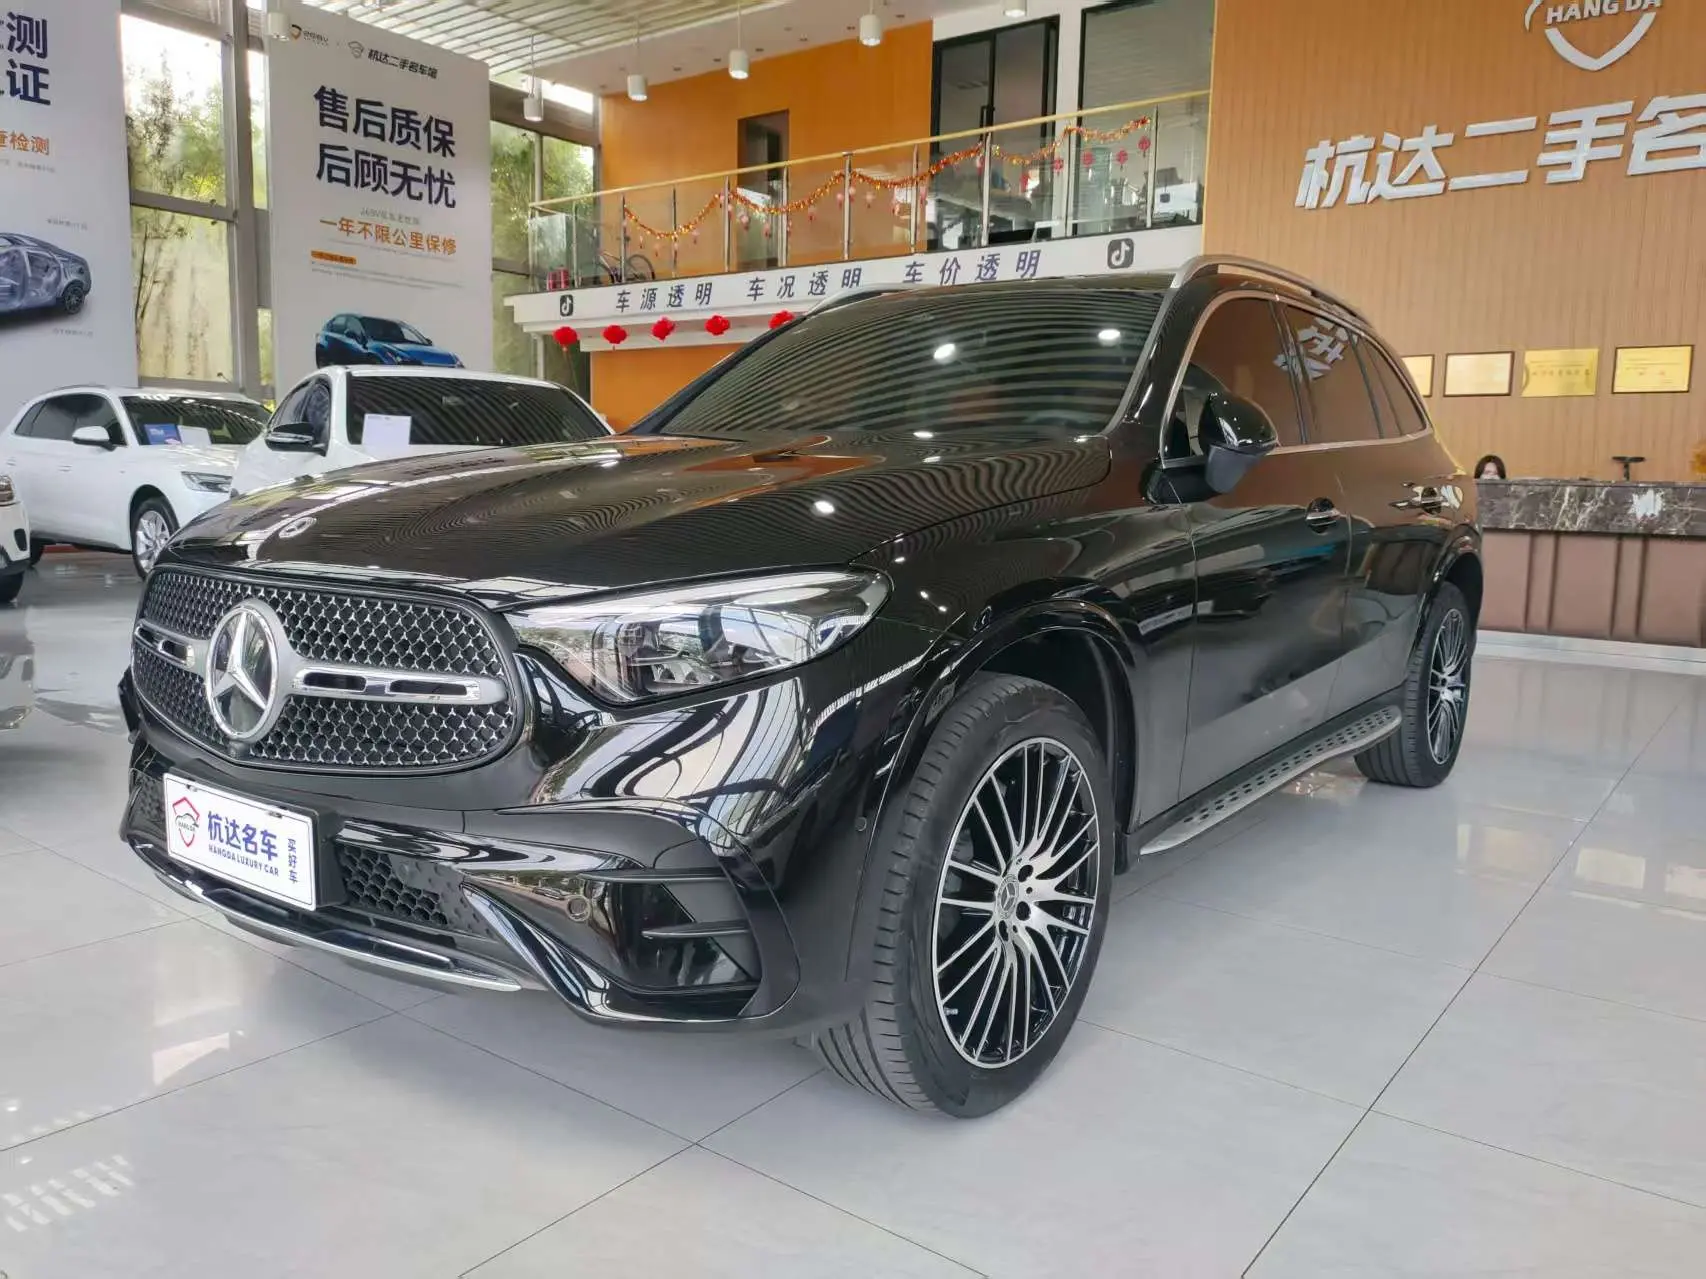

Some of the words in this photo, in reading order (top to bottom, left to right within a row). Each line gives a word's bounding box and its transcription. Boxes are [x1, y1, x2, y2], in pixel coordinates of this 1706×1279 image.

[0, 12, 47, 59] 测
[1546, 0, 1619, 24] HANG
[0, 58, 51, 105] 证
[313, 85, 456, 158] 售后质保
[1295, 93, 1706, 210] 杭达二手名
[316, 143, 456, 209] 后顾无忧
[319, 216, 457, 256] 一年不限公里保修
[615, 282, 713, 312] 车源透明
[746, 267, 862, 301] 车况透明
[902, 250, 1042, 285] 车价透明
[207, 811, 278, 861] 杭达名车
[208, 843, 235, 861] HANGDA
[236, 853, 262, 871] LUXURY
[264, 863, 279, 876] CAR
[287, 838, 299, 884] 买好车
